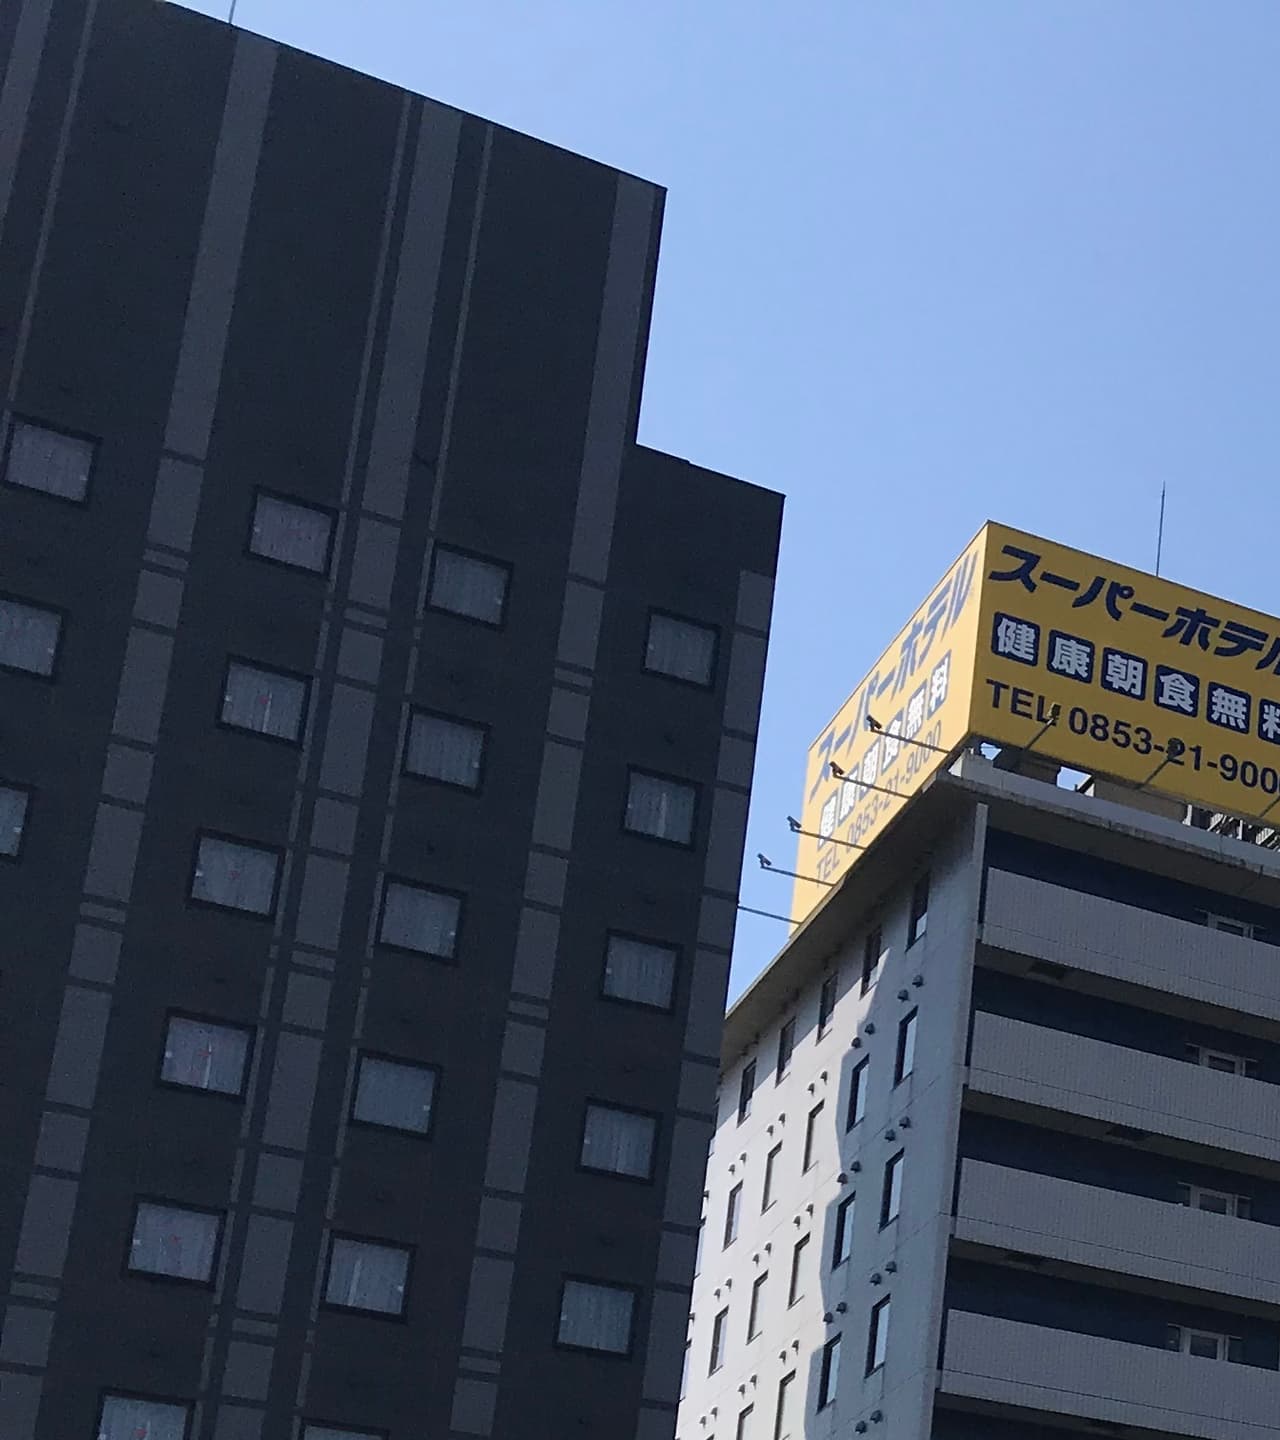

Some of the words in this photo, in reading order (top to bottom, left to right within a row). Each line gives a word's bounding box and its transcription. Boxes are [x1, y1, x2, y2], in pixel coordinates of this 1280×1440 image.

[809, 551, 978, 803] スーパーホテル
[986, 678, 1056, 726] TEL
